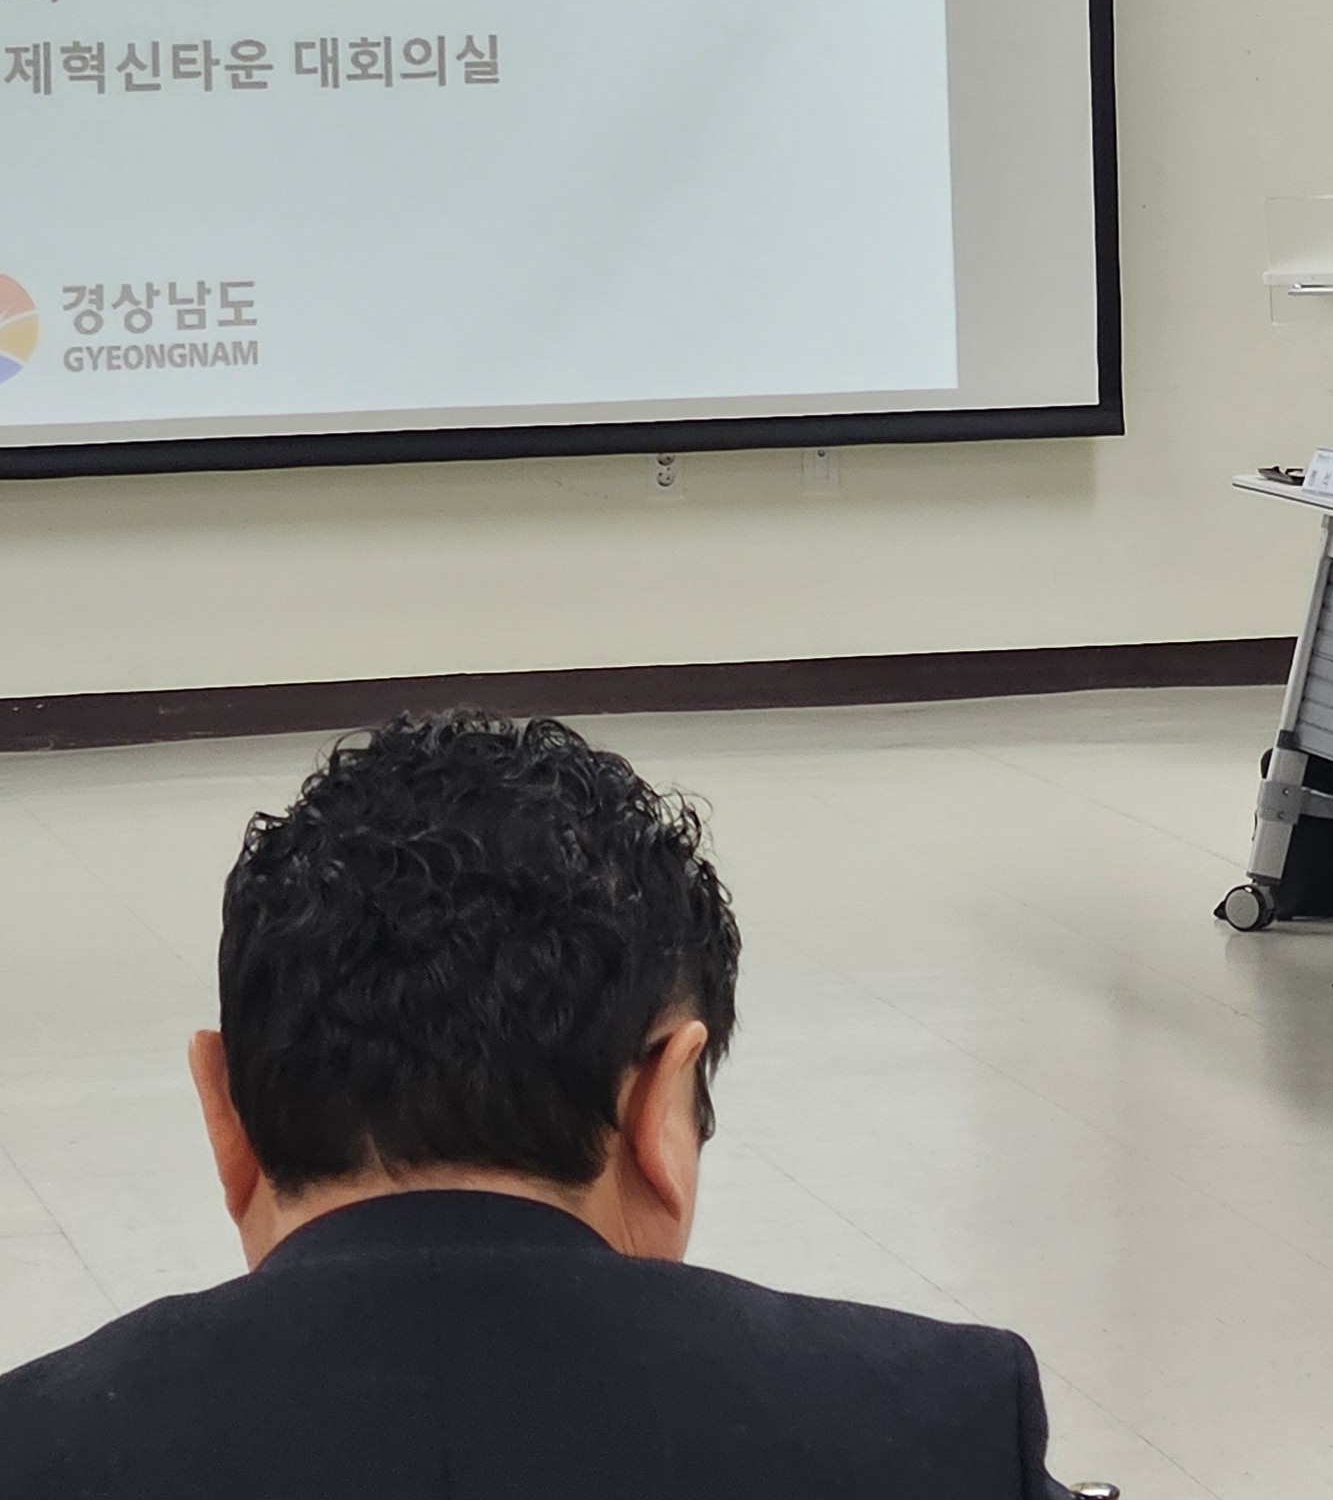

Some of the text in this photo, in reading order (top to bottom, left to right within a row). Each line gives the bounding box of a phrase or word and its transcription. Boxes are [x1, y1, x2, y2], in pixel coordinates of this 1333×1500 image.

[3, 34, 501, 96] 제혁신타운 대회의실
[62, 280, 258, 336] 경상남도
[63, 340, 259, 373] GYEONGNAM
